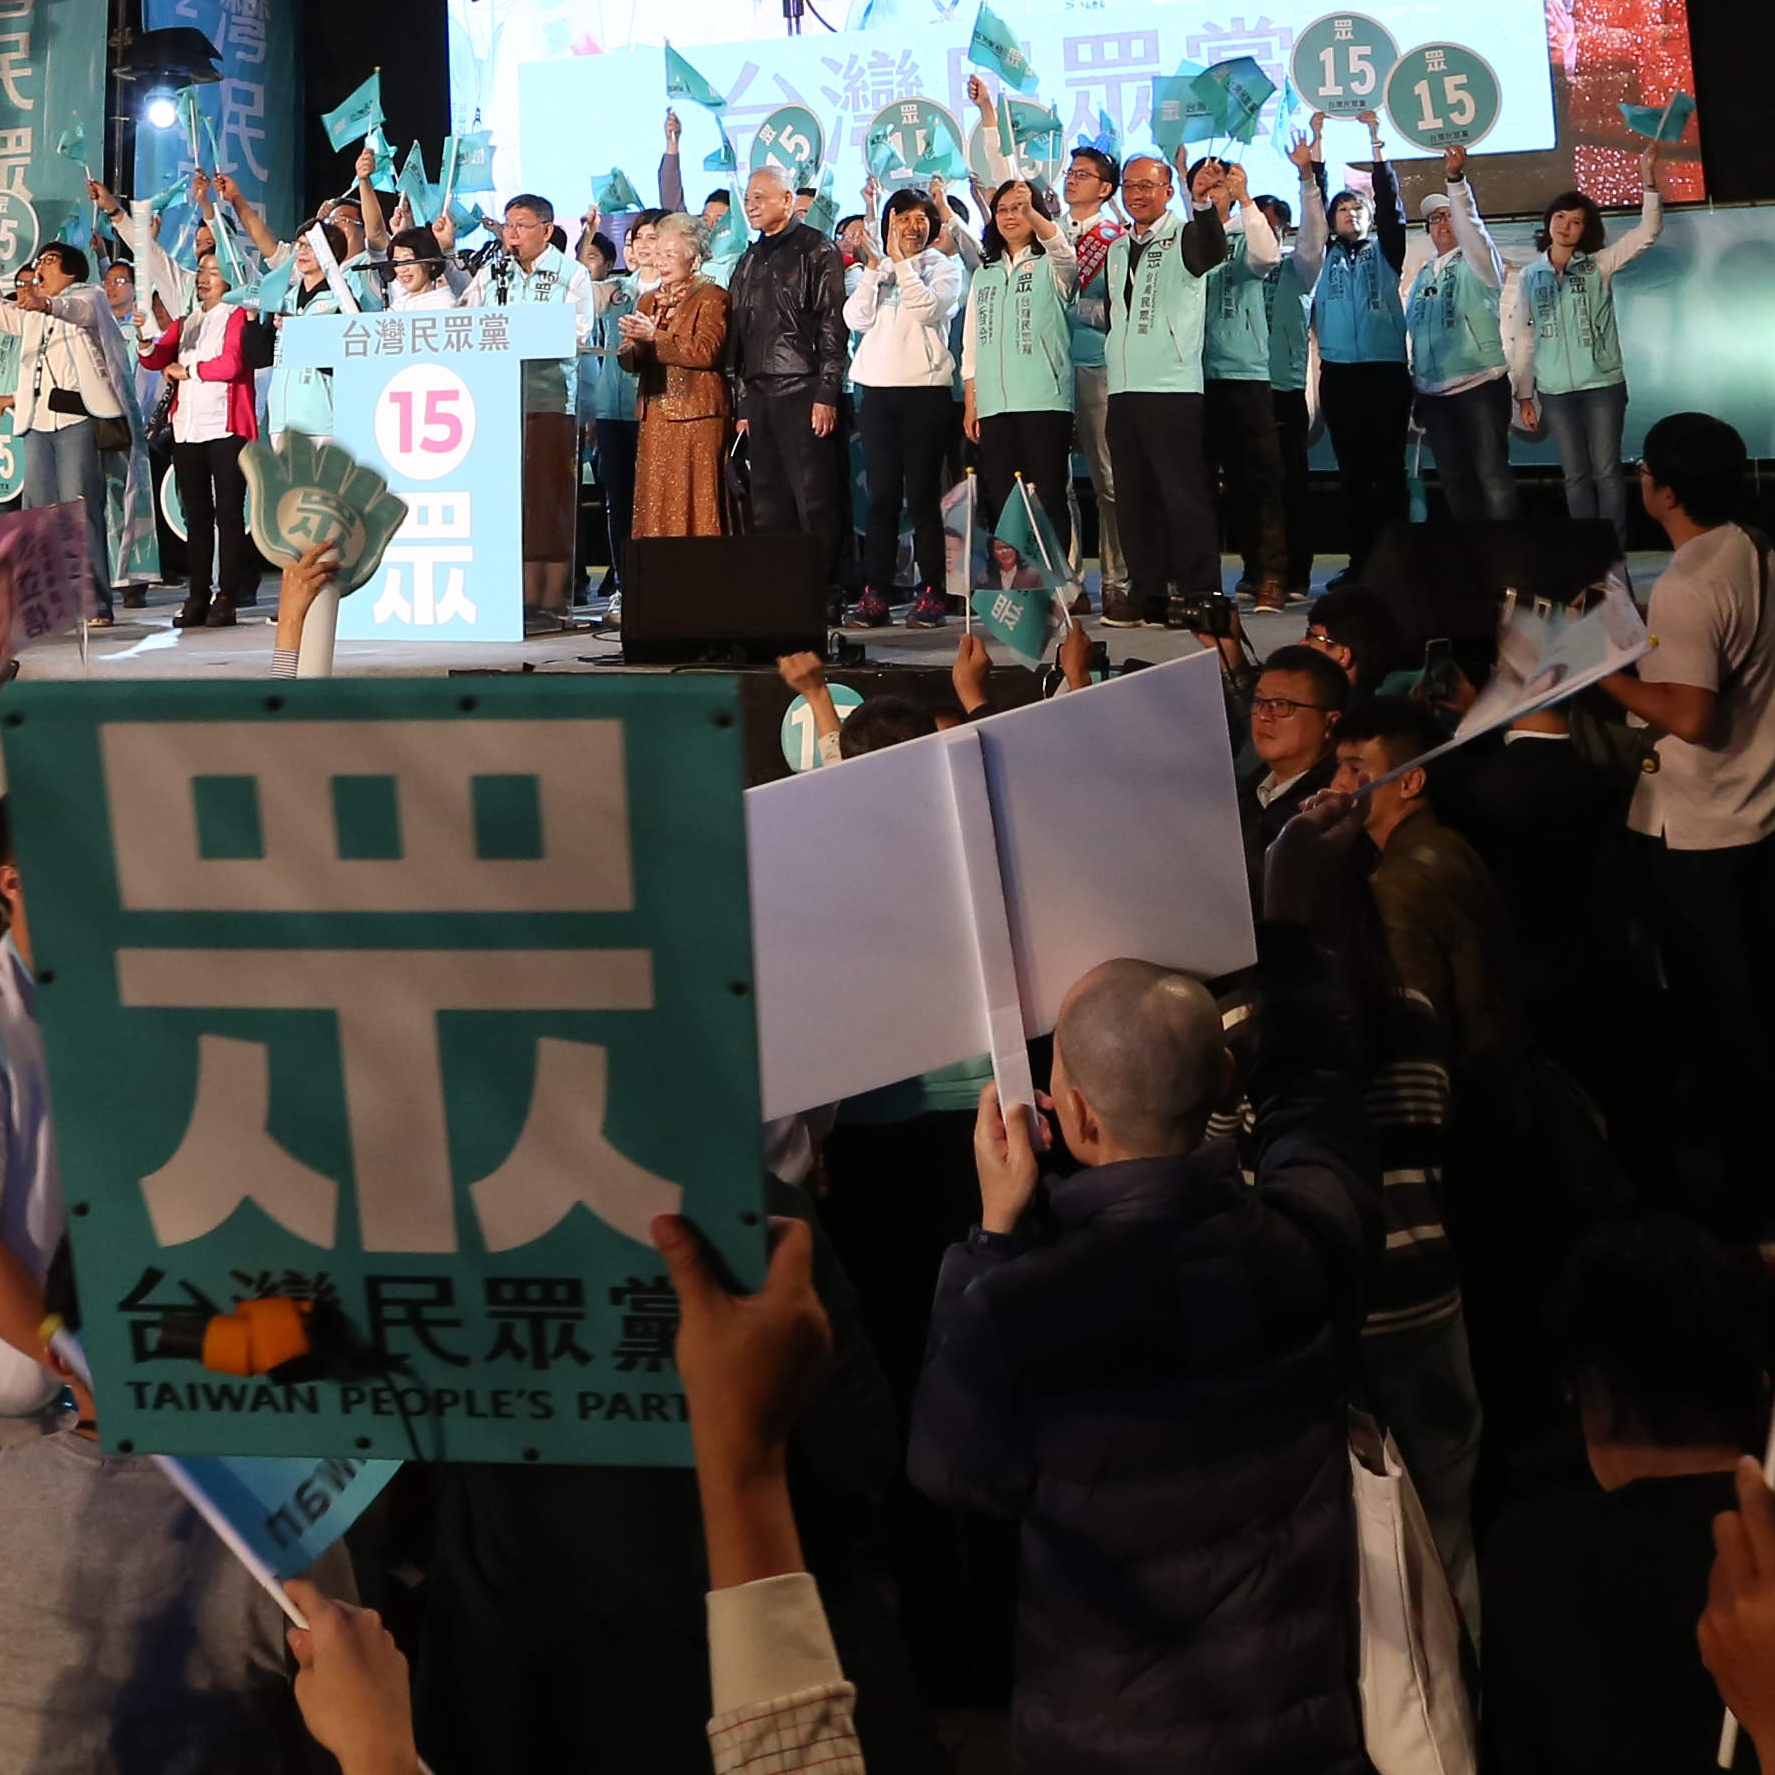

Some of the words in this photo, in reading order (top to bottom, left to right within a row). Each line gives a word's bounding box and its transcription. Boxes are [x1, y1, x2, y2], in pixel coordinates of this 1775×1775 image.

[1334, 19, 1354, 41] 眾
[1318, 45, 1377, 96] 15
[1425, 50, 1447, 72] 眾
[899, 104, 921, 124] 眾
[1413, 73, 1476, 131] 15
[1147, 251, 1163, 269] 眾
[534, 282, 552, 302] 眾
[1015, 272, 1033, 294] 眾
[341, 314, 512, 359] 台灣民眾黨
[389, 389, 463, 454] 15
[372, 491, 478, 626] 眾
[991, 594, 1024, 631] 眾
[98, 717, 686, 1255] 眾
[127, 1379, 320, 1417] TAIWAN
[340, 1382, 553, 1424] PEOPLE'S
[576, 1387, 695, 1425] PART
